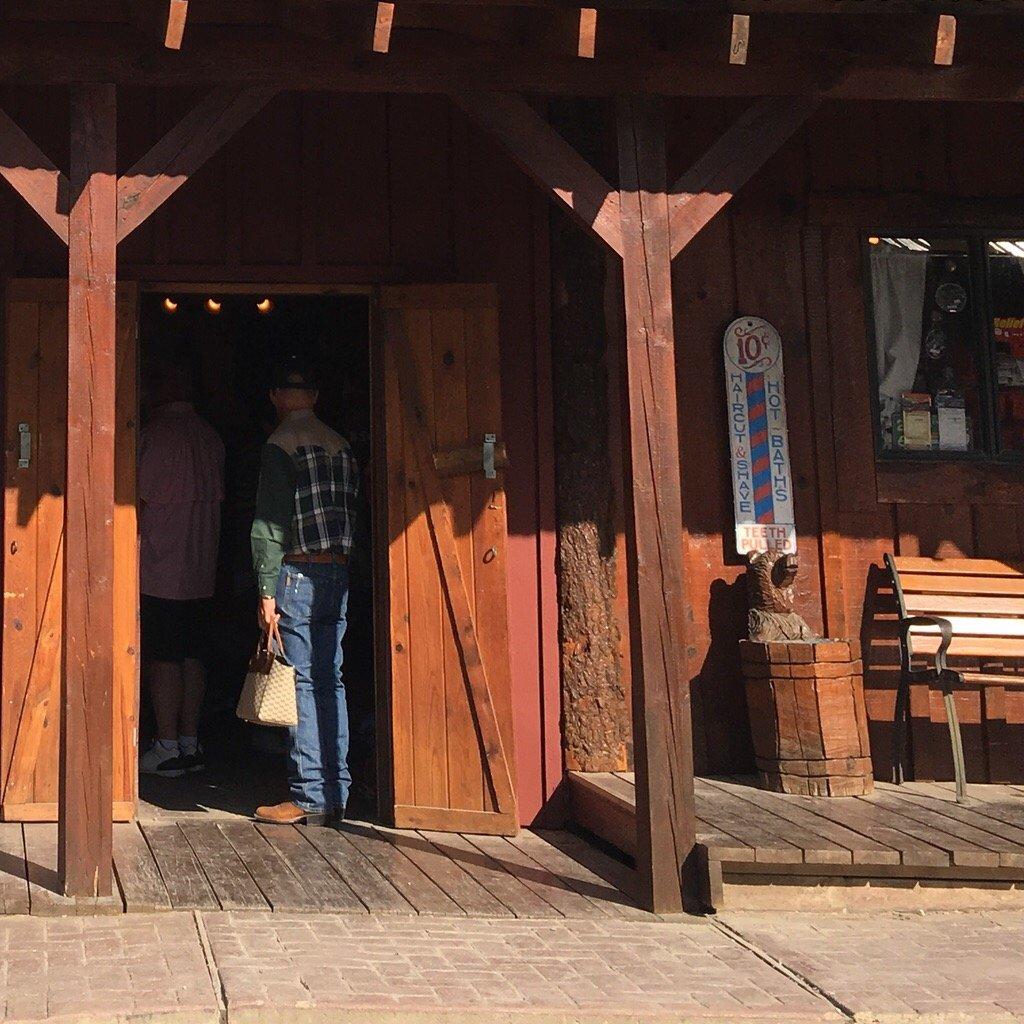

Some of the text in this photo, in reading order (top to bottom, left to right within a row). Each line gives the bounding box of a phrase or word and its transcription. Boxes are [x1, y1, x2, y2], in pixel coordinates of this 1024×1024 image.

[730, 373, 751, 513] HAIRCUT & SHAVE
[767, 380, 788, 502] HOT BATHS
[741, 537, 791, 552] PULLED
[743, 526, 786, 539] TEETH
